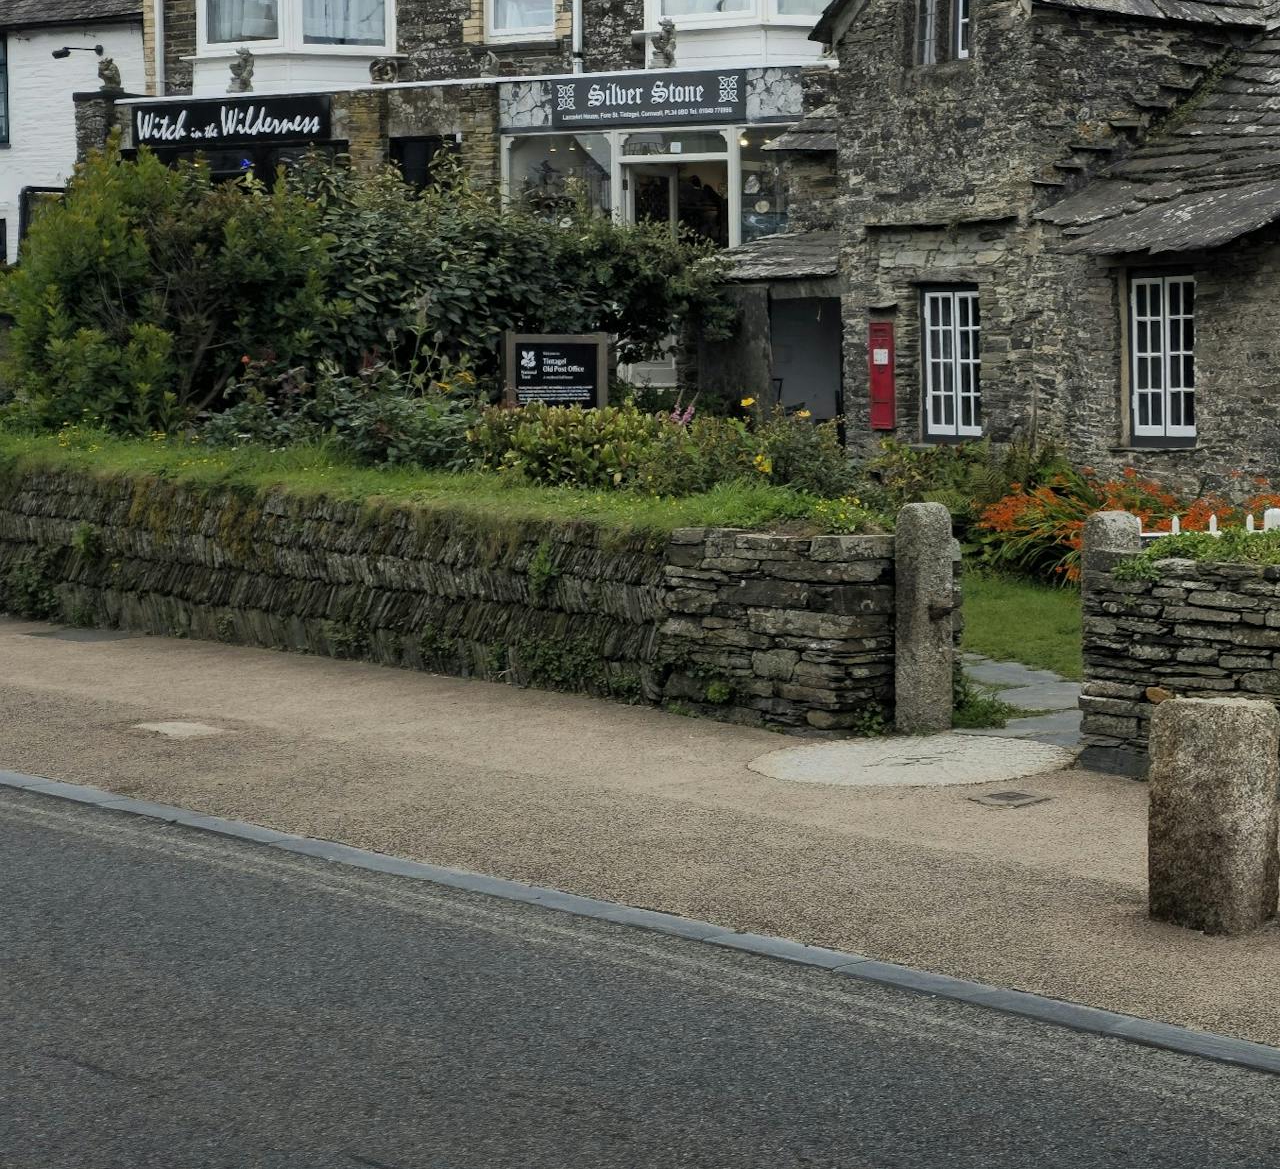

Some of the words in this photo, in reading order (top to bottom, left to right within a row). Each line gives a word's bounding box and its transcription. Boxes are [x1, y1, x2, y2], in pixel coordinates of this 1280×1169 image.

[588, 83, 644, 107] Silver
[651, 80, 705, 105] Stone
[137, 110, 188, 141] Witch
[190, 127, 203, 139] in
[204, 123, 218, 139] the
[220, 106, 320, 136] Wilderness
